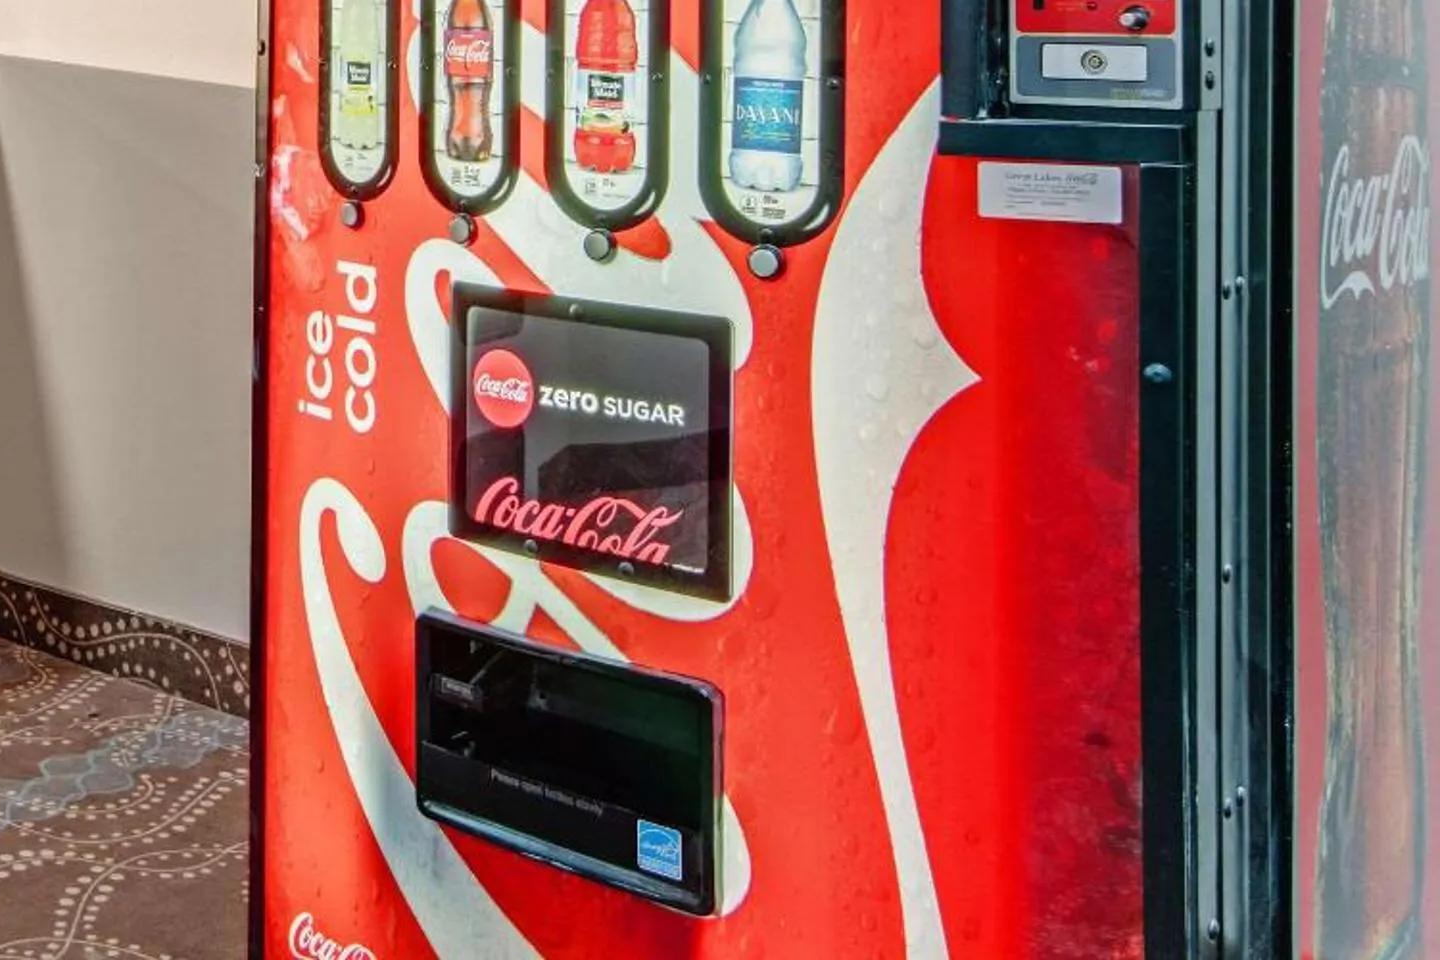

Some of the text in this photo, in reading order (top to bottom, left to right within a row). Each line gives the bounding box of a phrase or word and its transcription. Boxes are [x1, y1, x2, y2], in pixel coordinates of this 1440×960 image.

[298, 309, 335, 422] ice
[335, 259, 378, 434] cold
[474, 373, 685, 427] Coca-Cola zero SUGAR
[475, 476, 684, 566] Coca-Cola
